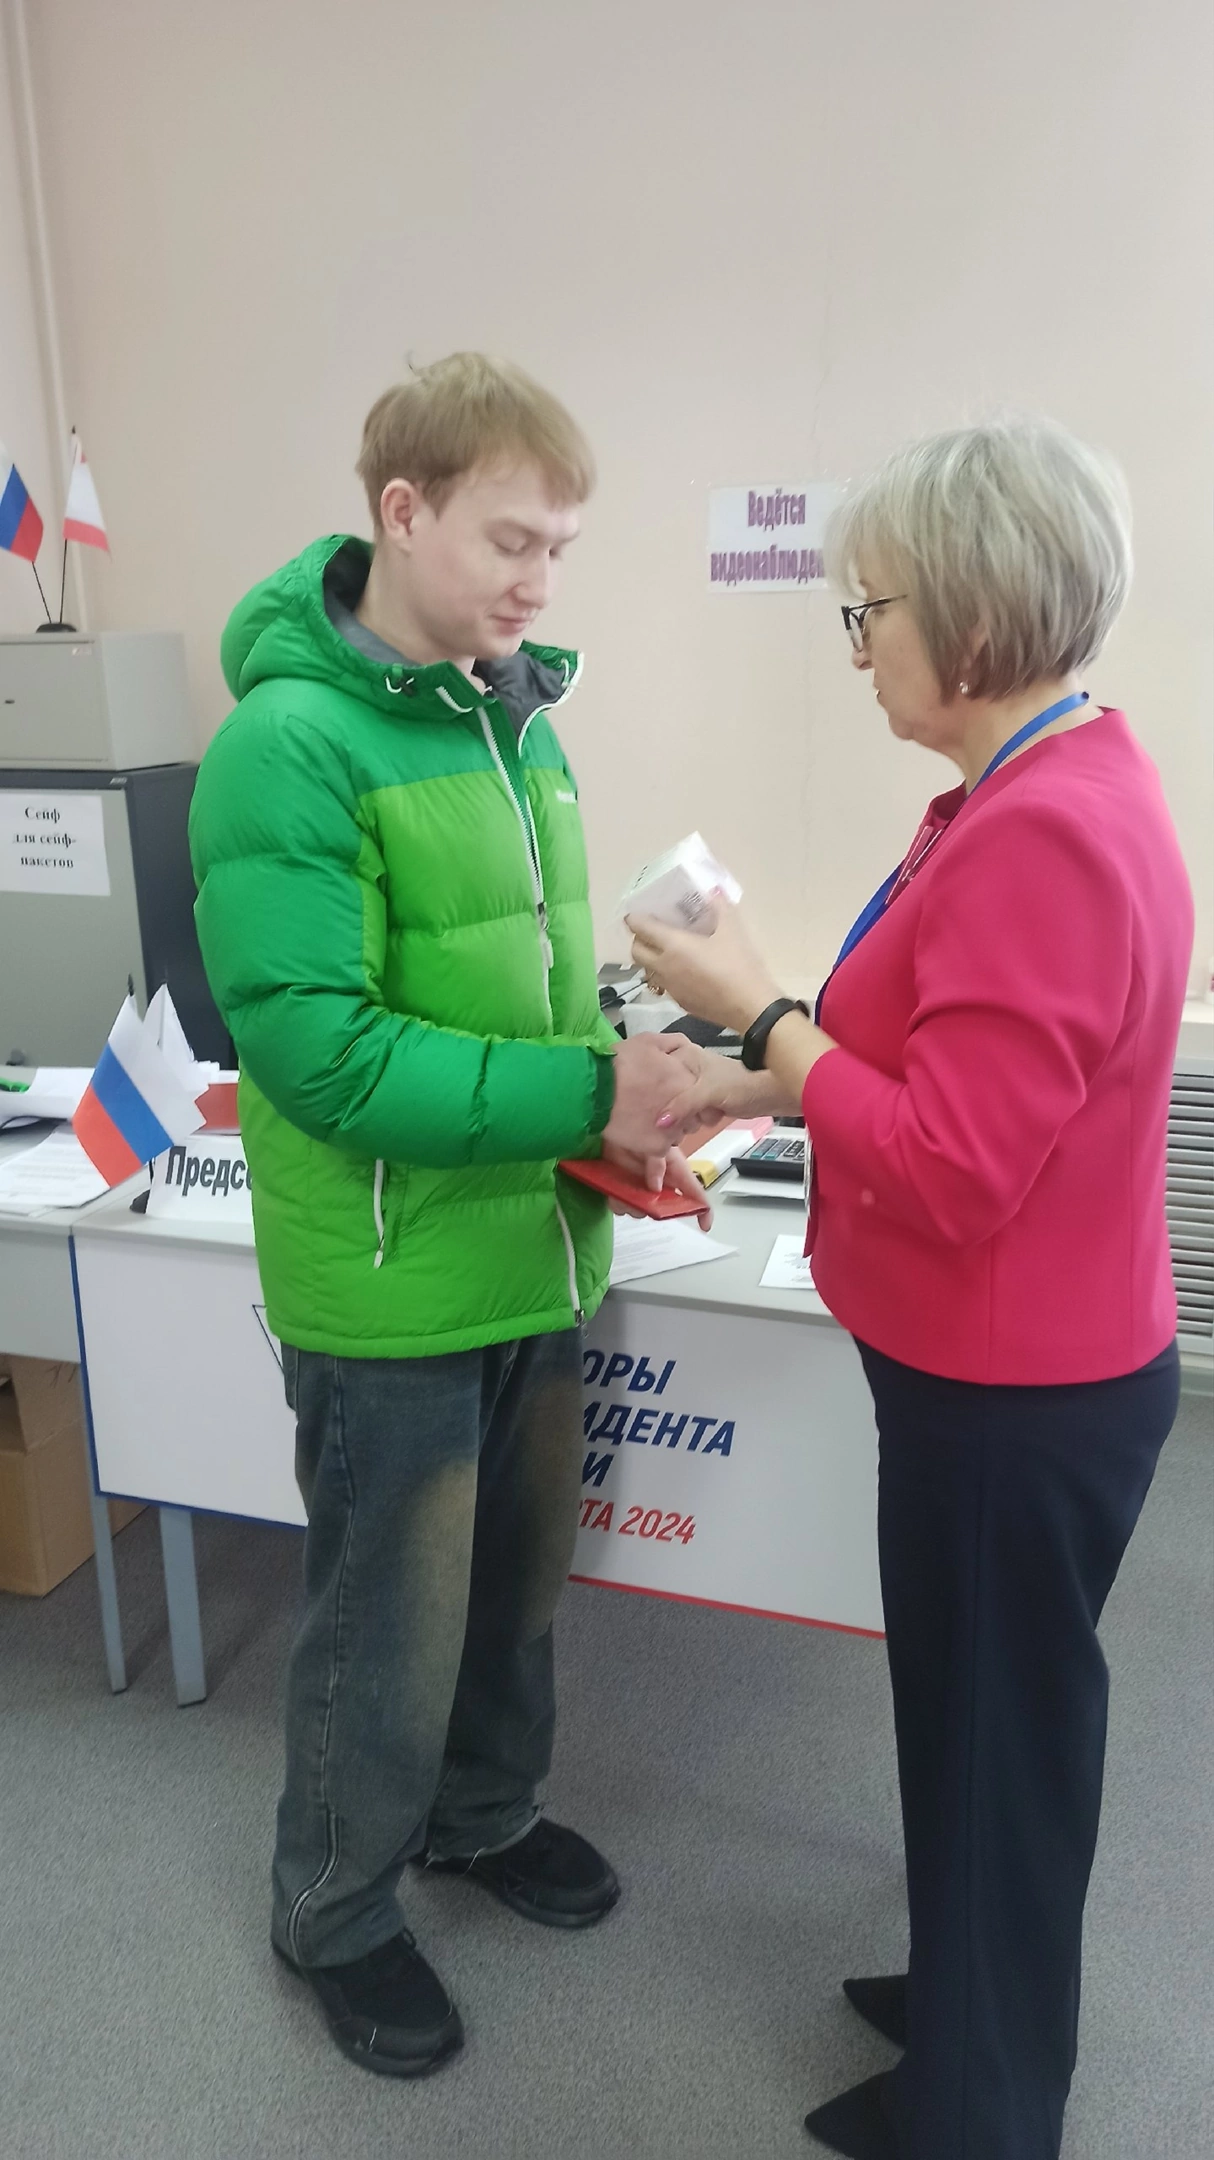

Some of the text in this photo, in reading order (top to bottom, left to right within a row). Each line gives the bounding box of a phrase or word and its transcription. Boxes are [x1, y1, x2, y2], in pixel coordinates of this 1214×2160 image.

[747, 487, 806, 532] Ведётся
[24, 805, 61, 824] Сейф
[12, 832, 77, 849] для сейф-
[20, 856, 74, 869] пакетов
[579, 1498, 697, 1546] ТА 2024
